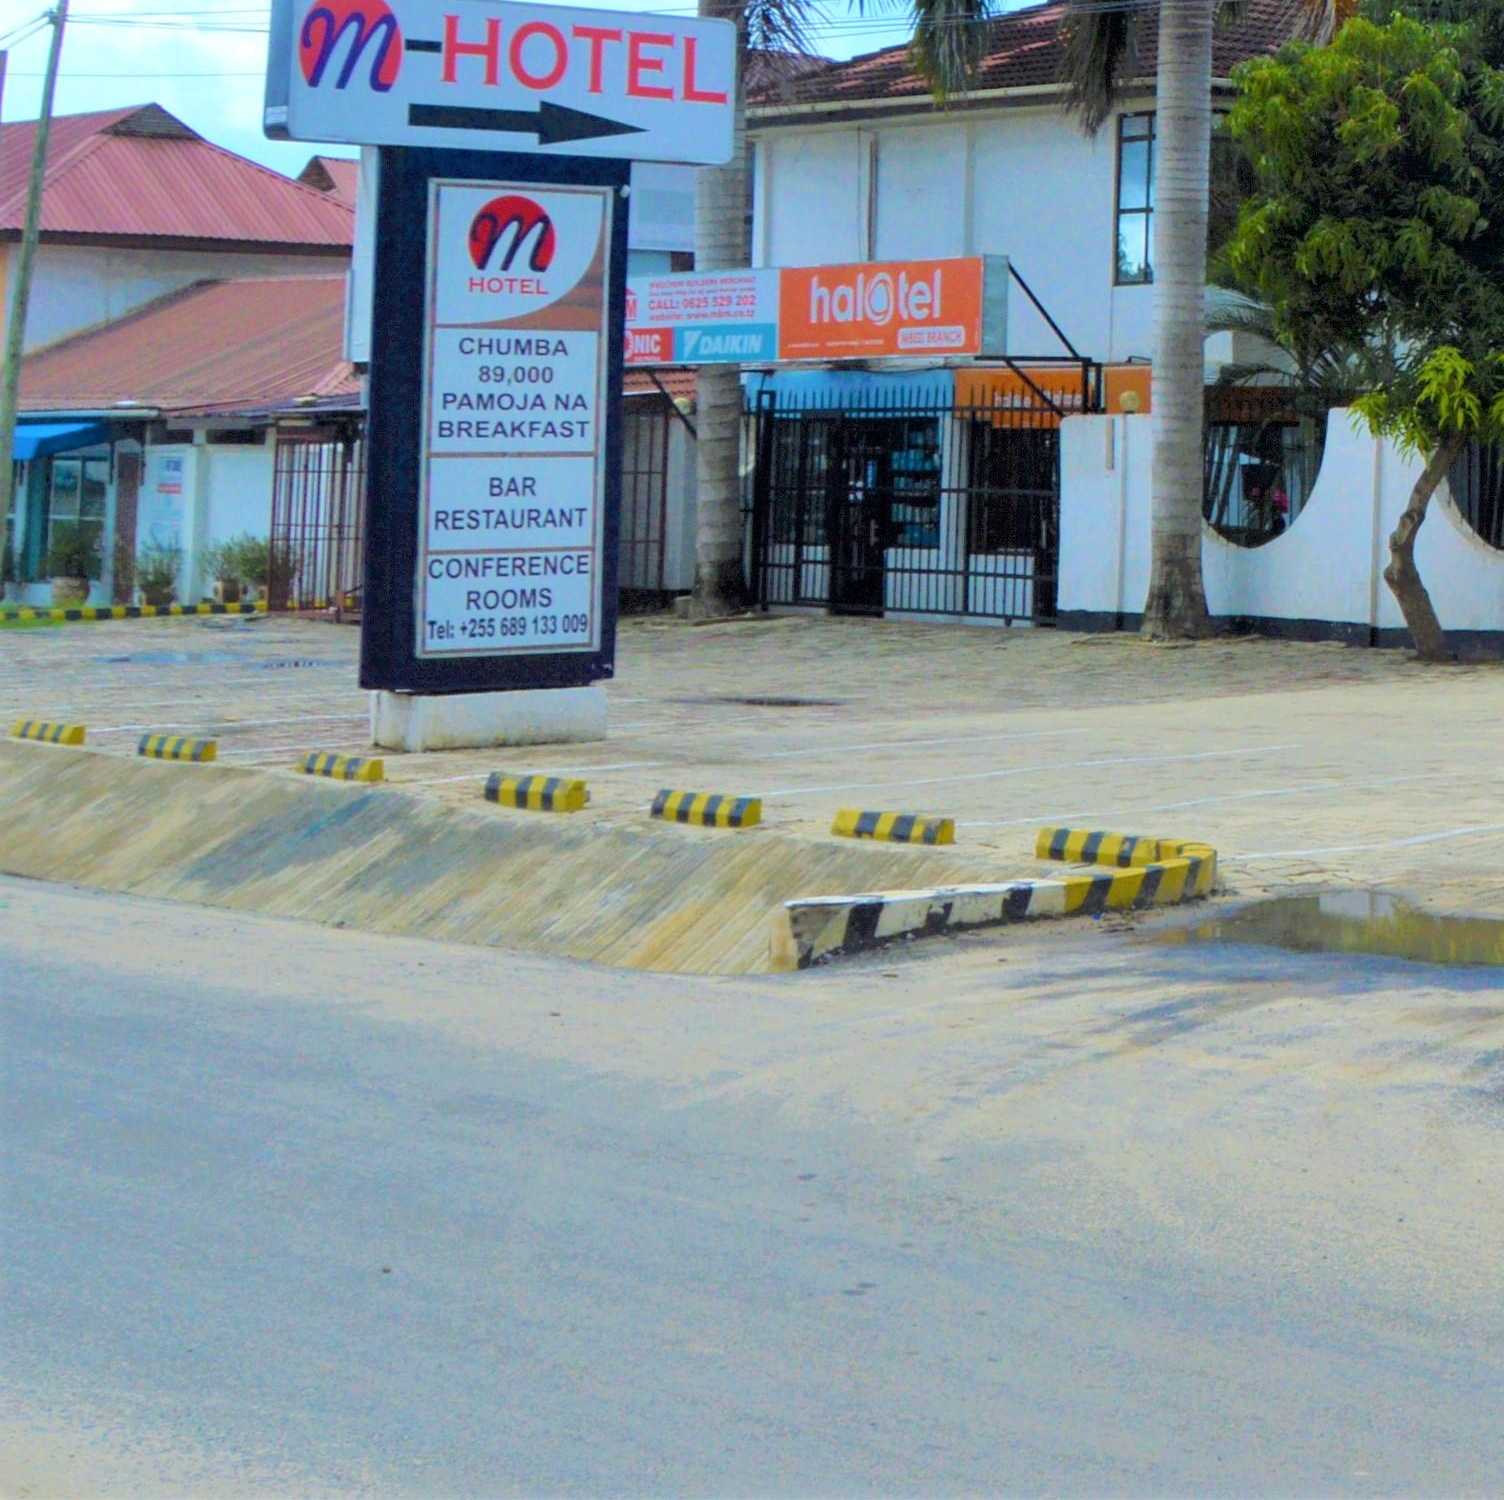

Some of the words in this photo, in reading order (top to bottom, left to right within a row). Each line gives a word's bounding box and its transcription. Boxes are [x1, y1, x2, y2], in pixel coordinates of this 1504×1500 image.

[468, 276, 550, 295] HOTEL
[649, 299, 679, 311] CALL:
[682, 296, 708, 309] 0625
[735, 295, 756, 306] 202
[810, 268, 942, 326] halotel
[458, 337, 569, 357] CHUMBA
[699, 334, 762, 355] DAIKIN
[478, 365, 554, 386] 89,000
[442, 393, 546, 411] PAMOJA
[554, 394, 589, 411] NA
[437, 420, 590, 439] BREAKFAST
[489, 476, 536, 498] BAR
[434, 508, 587, 531] RESTAURANT
[428, 554, 590, 580] CONFERENCE
[466, 587, 552, 611] ROOMS
[427, 619, 454, 640] Tel:
[459, 617, 495, 638] +255
[500, 616, 527, 637] 689
[532, 615, 557, 635] 133
[562, 613, 588, 634] 009
